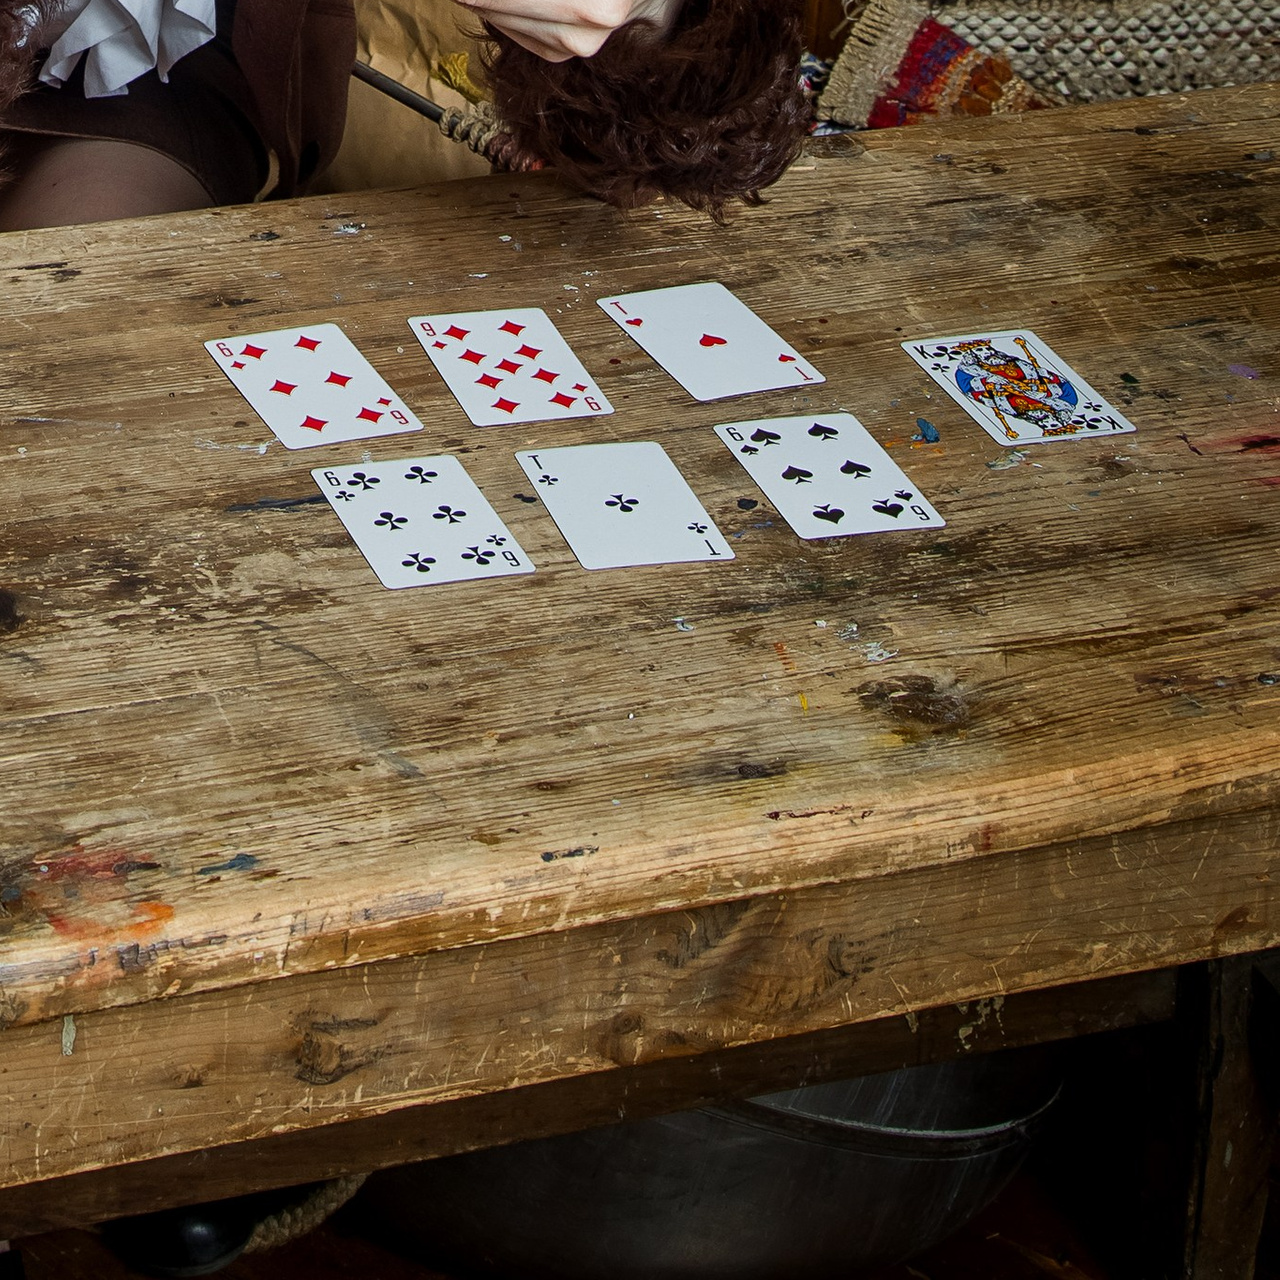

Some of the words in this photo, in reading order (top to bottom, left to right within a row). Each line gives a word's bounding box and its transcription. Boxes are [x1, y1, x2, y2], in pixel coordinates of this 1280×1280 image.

[610, 301, 628, 315] T
[420, 322, 436, 337] 9
[216, 342, 233, 357] 6
[913, 345, 933, 359] K
[584, 396, 602, 411] 9
[390, 410, 409, 425] 6
[1102, 415, 1124, 430] K
[726, 427, 744, 442] 6
[528, 455, 542, 470] T
[324, 471, 341, 486] 6
[502, 551, 521, 567] 6
